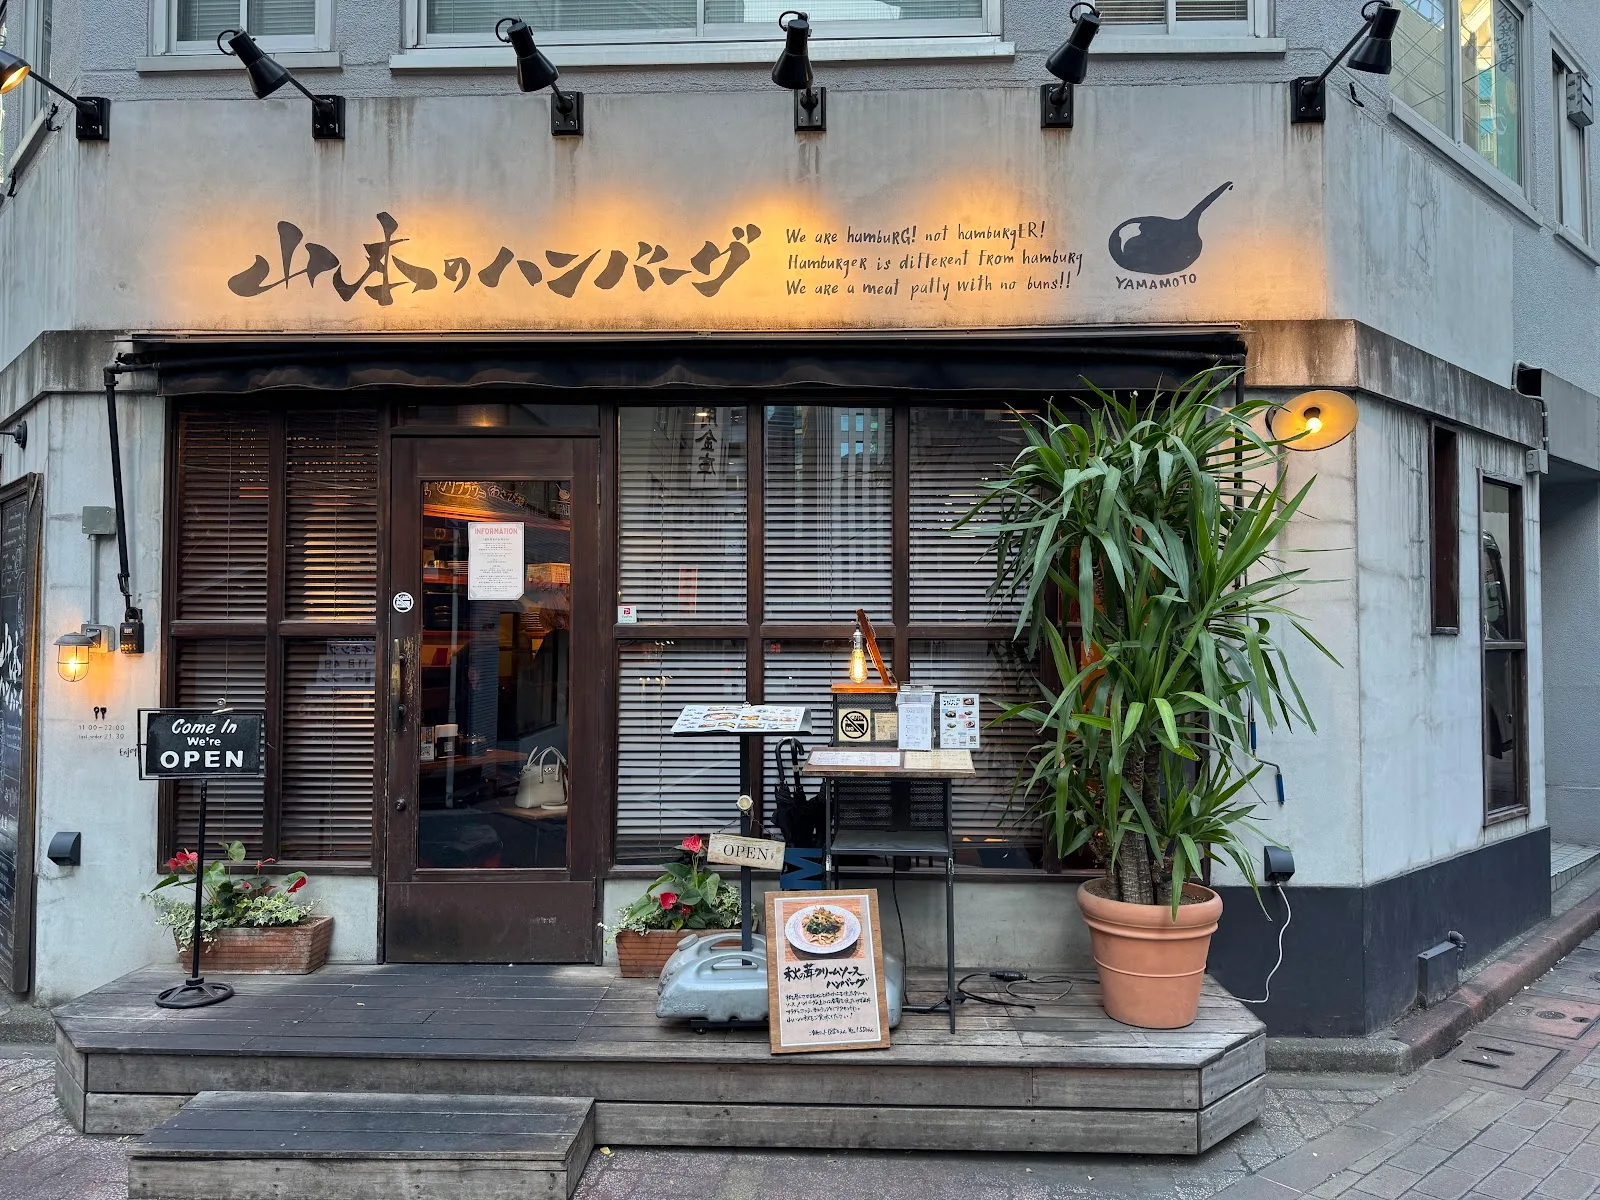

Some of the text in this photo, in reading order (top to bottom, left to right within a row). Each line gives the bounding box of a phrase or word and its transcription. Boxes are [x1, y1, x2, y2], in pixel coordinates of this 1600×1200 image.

[786, 228, 806, 243] We
[925, 225, 949, 241] not
[227, 211, 761, 305] 山本のハンバーグ
[876, 257, 891, 270] is
[786, 278, 806, 295] We
[847, 284, 855, 294] a
[863, 278, 900, 295] meat
[910, 276, 949, 301] patty
[957, 274, 992, 292] with
[1000, 280, 1018, 290] no
[1027, 271, 1071, 290] buns!!
[1115, 273, 1197, 290] YAMAMOTO
[474, 527, 518, 535] INFORMATION
[171, 718, 238, 734] Come In
[186, 736, 221, 747] We're
[160, 750, 244, 769] OPEN
[723, 843, 770, 861] OPEN
[826, 977, 870, 990] ハンバーグ
